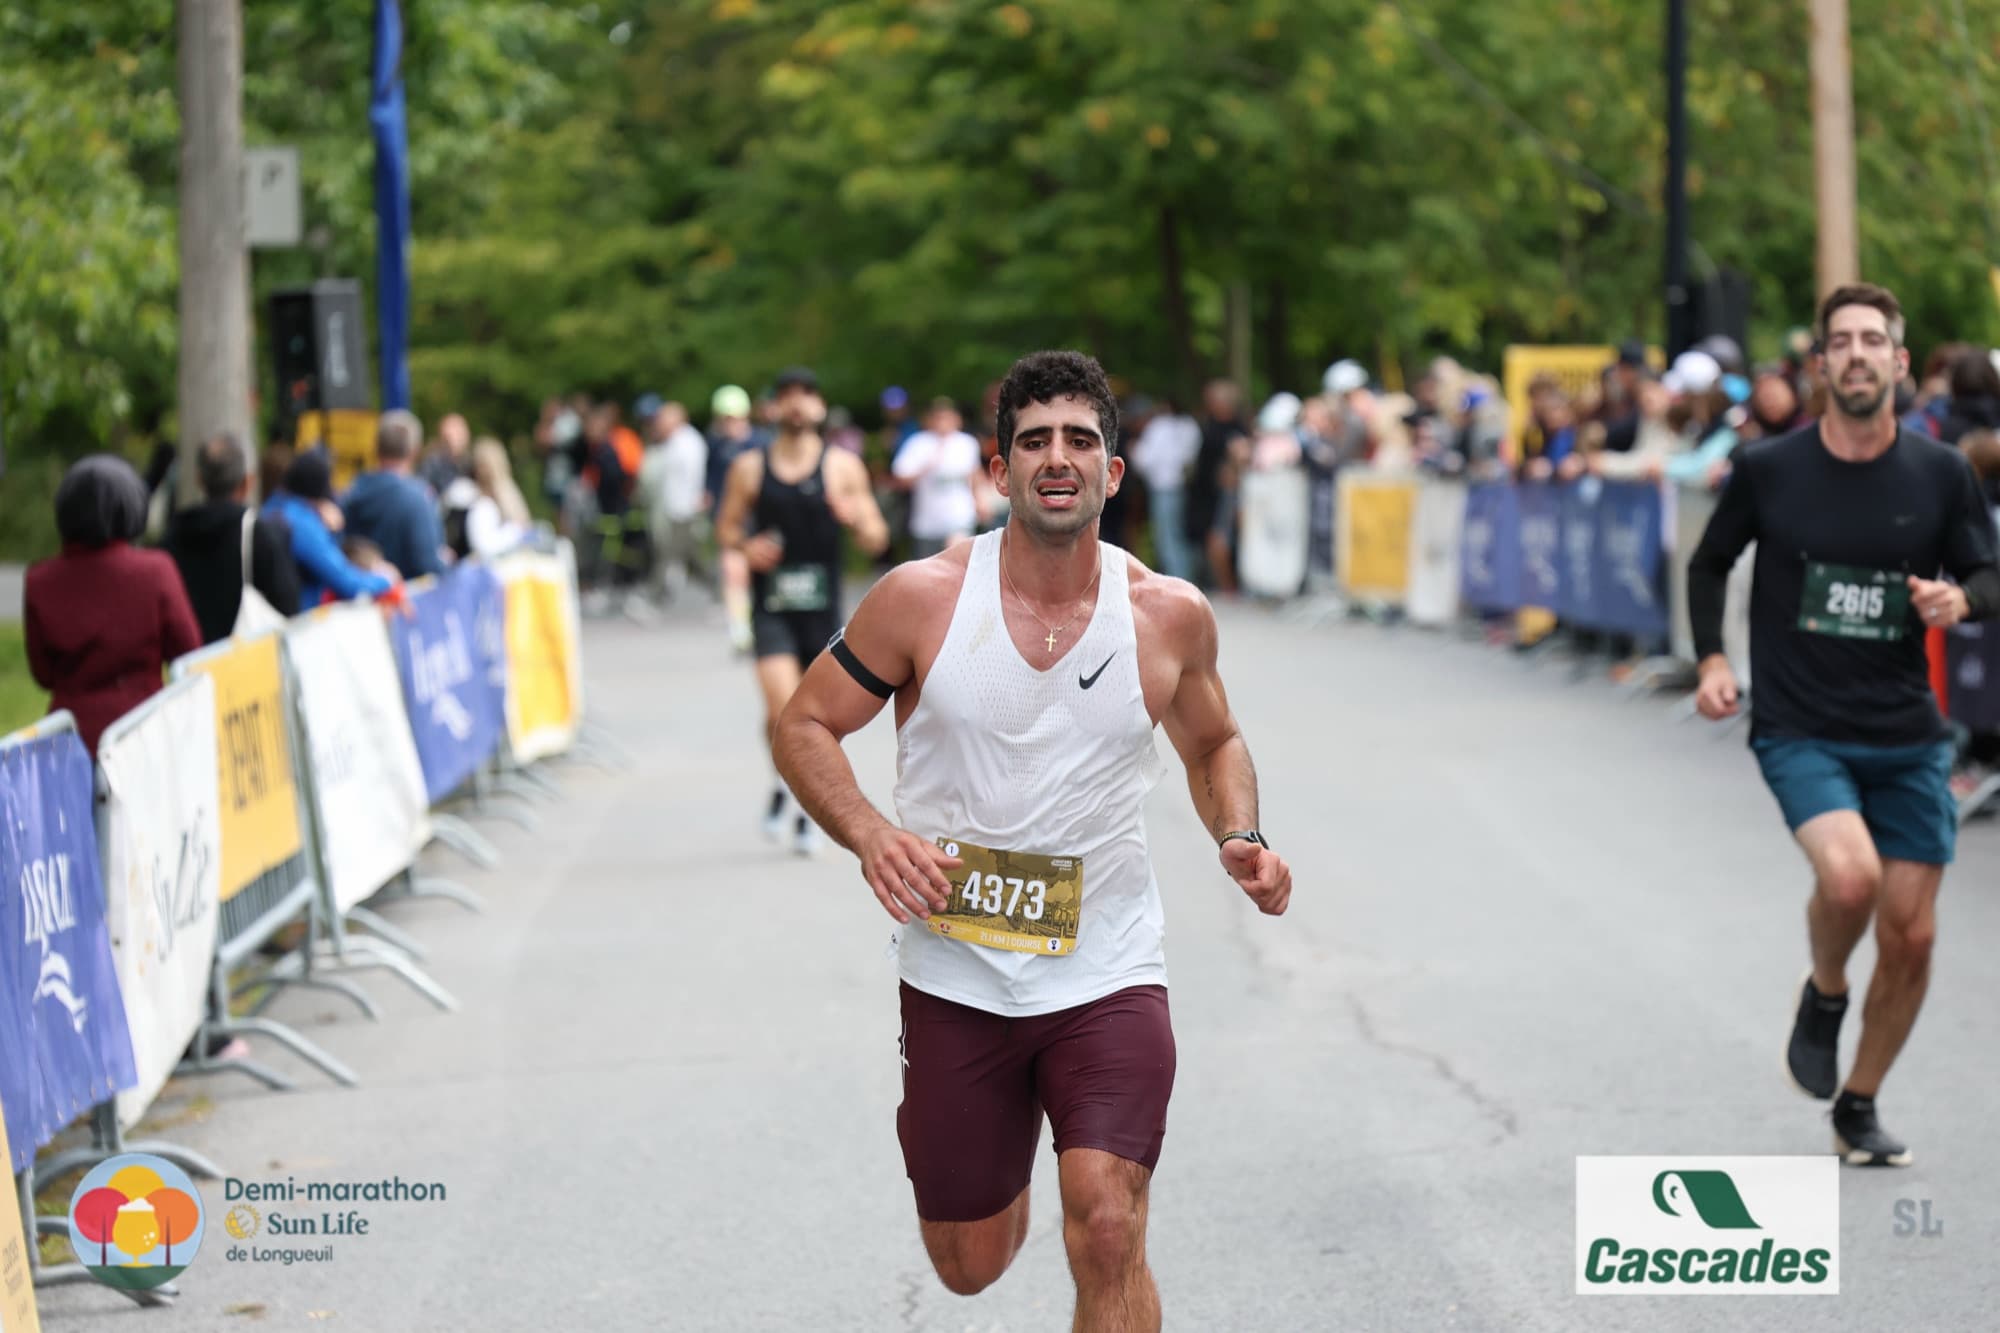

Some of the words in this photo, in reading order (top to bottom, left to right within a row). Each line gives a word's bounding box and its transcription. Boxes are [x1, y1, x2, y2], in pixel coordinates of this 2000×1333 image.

[1826, 582, 1885, 619] 2615
[961, 870, 1046, 920] 4373
[1011, 937, 1041, 949] COURSE
